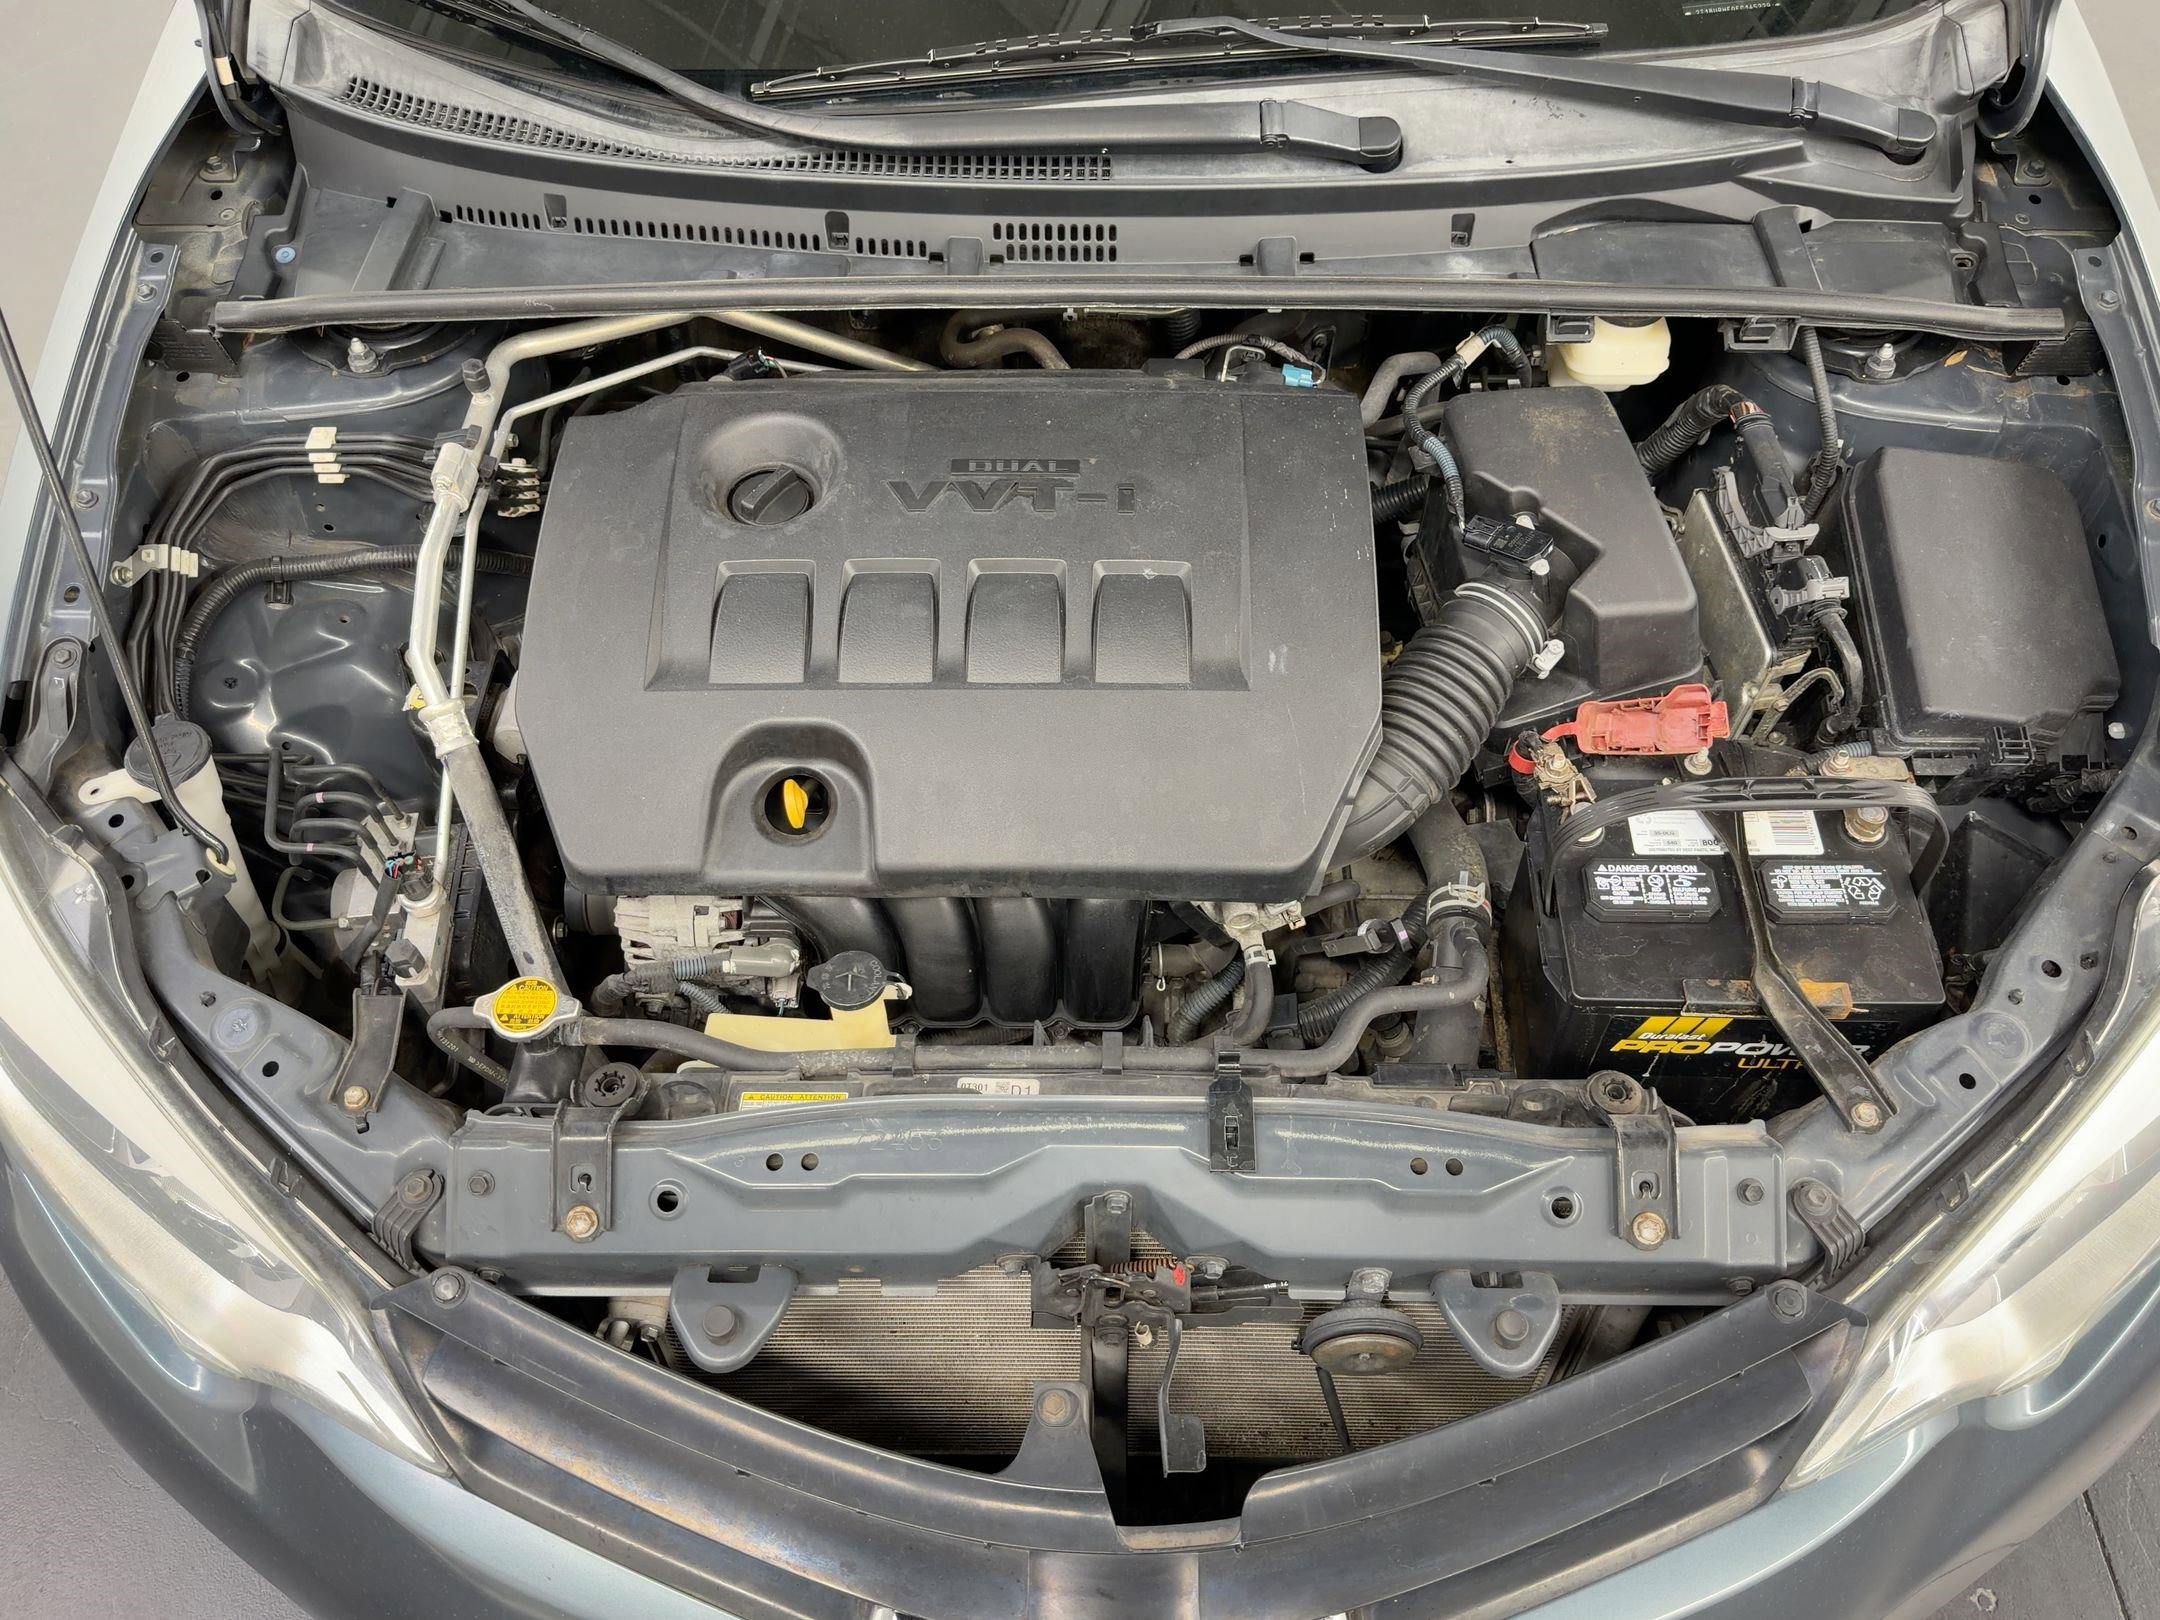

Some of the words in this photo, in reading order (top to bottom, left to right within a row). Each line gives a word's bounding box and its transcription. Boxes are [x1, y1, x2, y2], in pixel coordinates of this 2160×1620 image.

[968, 459, 1069, 473] DUAL
[1606, 864, 1650, 873] DANGER
[1659, 864, 1698, 873] POISON
[1637, 1032, 1707, 1041] Duralast
[759, 1093, 794, 1101] CAUTION
[799, 1093, 842, 1101] ATTENTION
